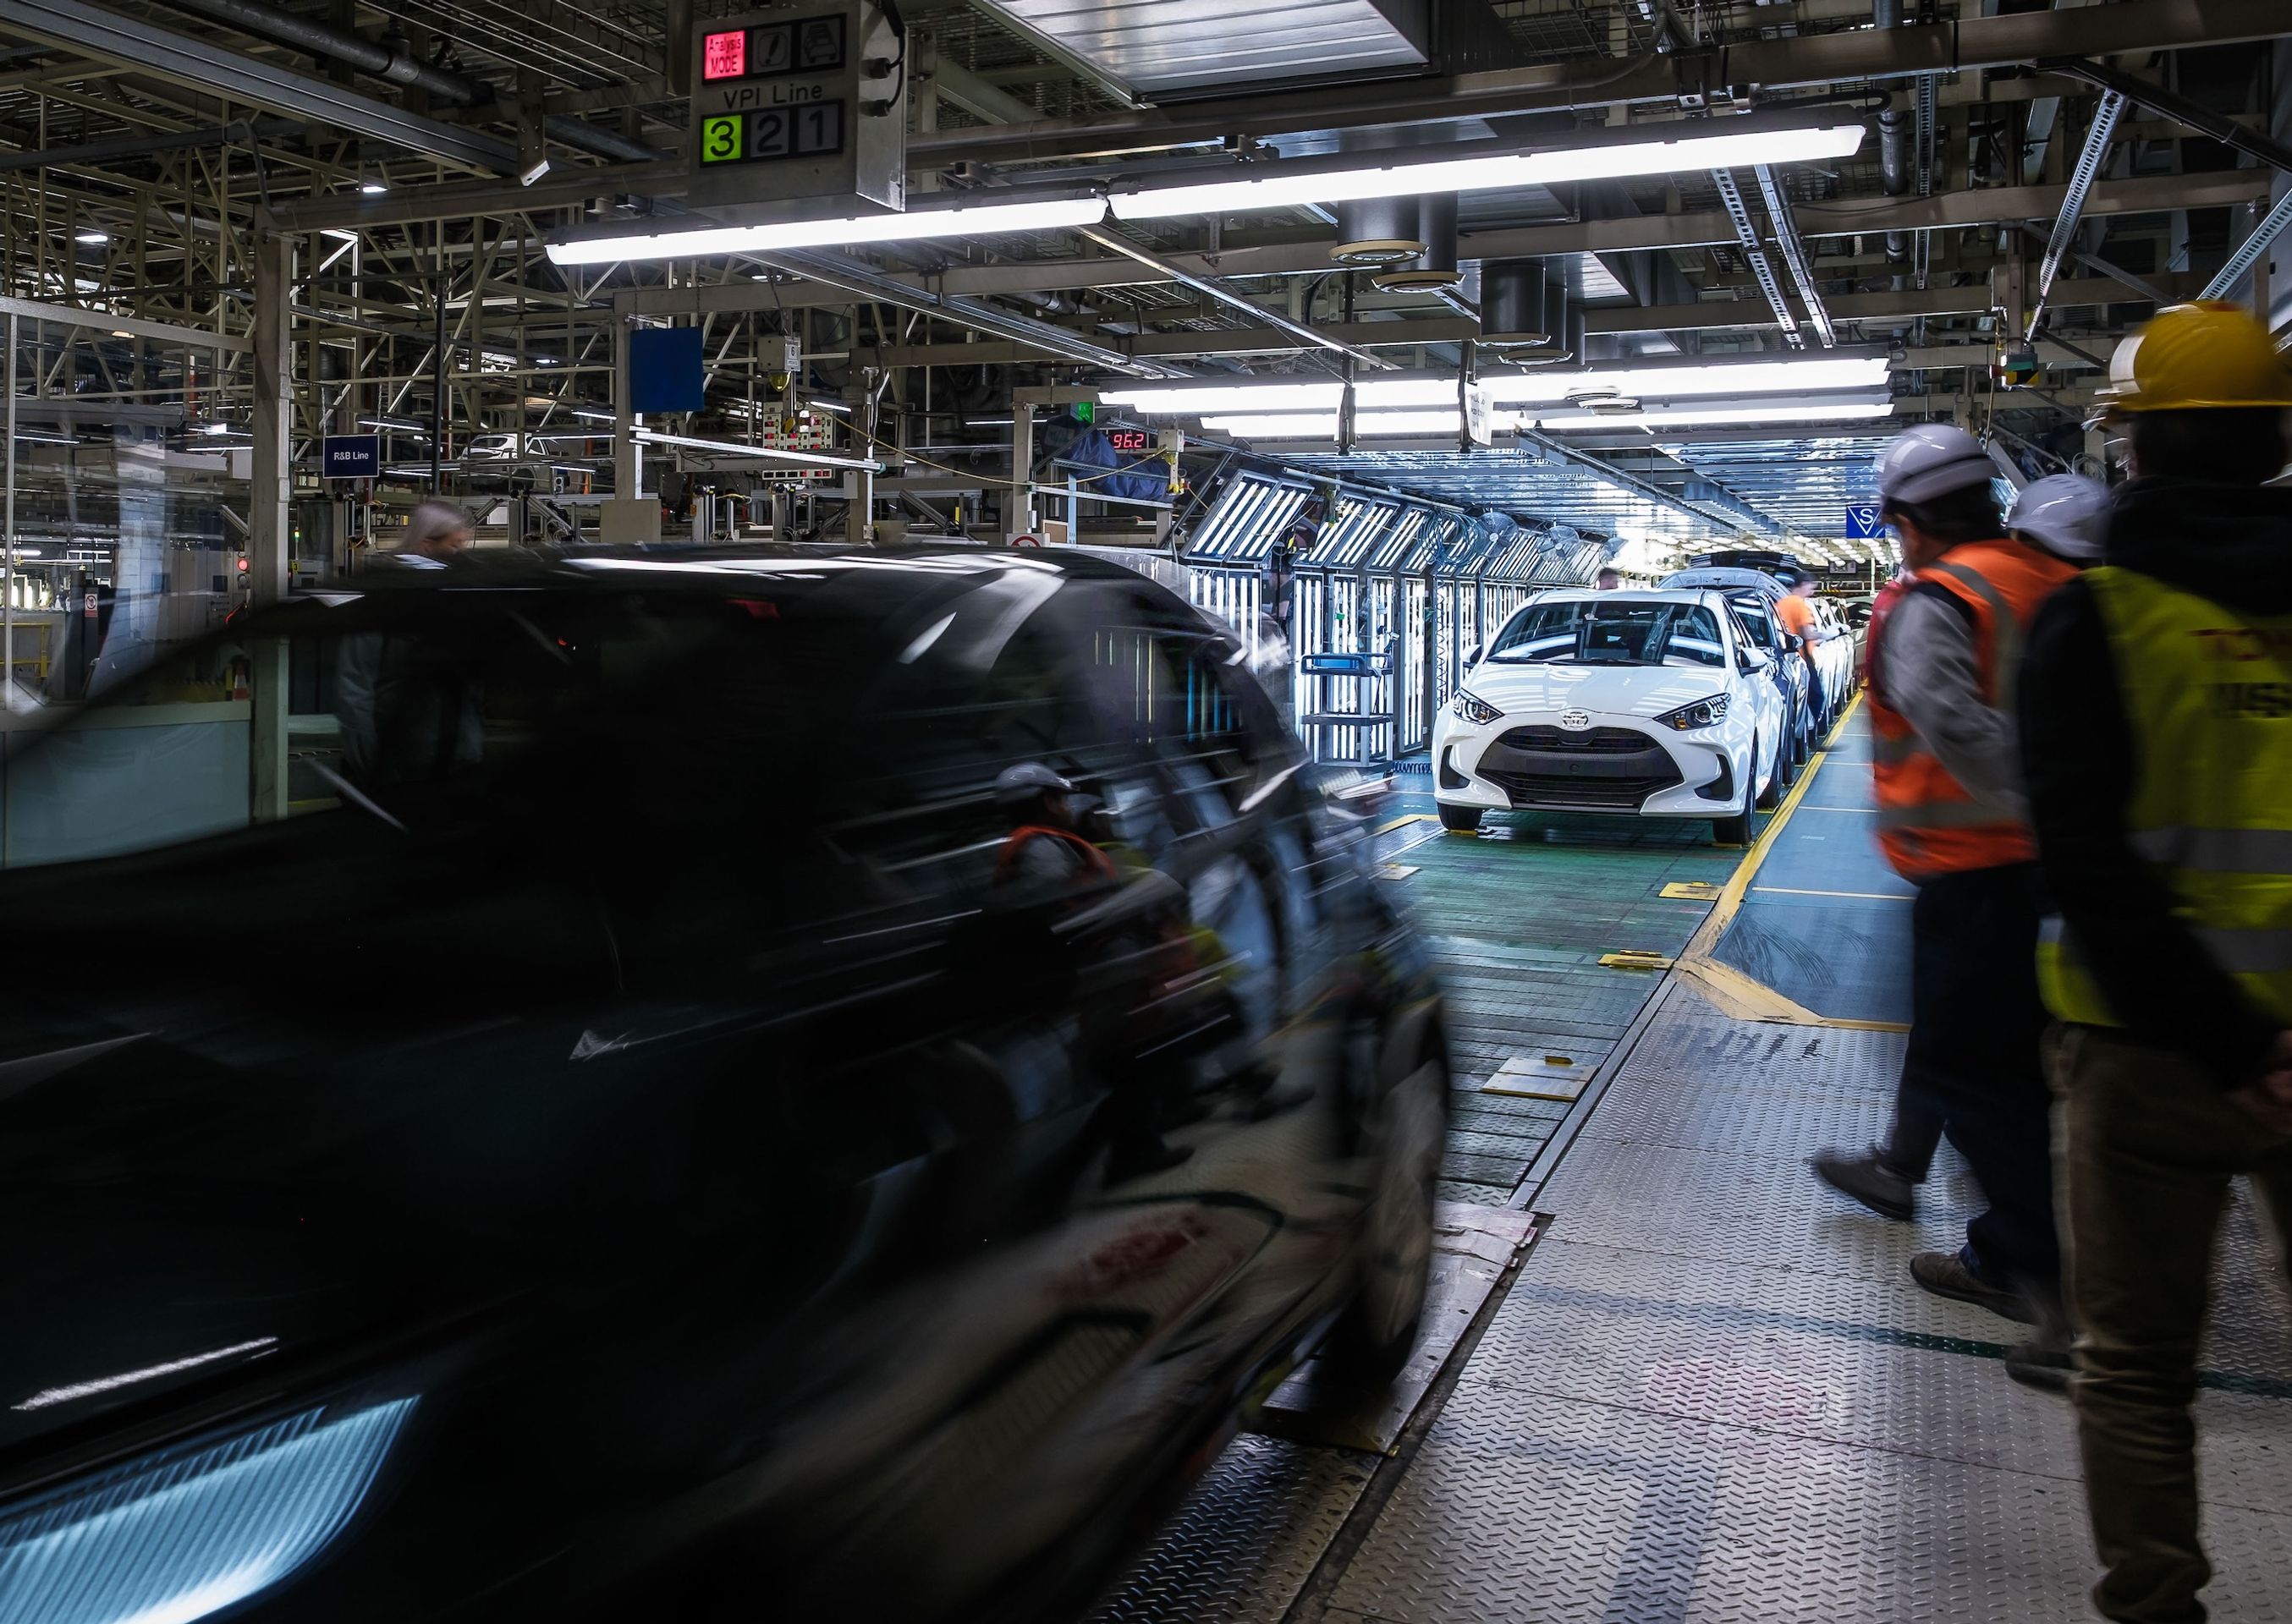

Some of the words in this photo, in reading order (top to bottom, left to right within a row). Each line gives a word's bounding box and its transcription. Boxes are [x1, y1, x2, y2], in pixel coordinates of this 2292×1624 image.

[708, 37, 741, 53] Analysis
[711, 55, 738, 74] MODE
[723, 87, 760, 109] VPI
[772, 83, 822, 104] Line
[710, 120, 734, 157] 3
[757, 114, 782, 152] 2
[809, 109, 823, 147] 1
[333, 451, 351, 460] R&B
[352, 451, 369, 459] Line
[1859, 508, 1874, 524] S
